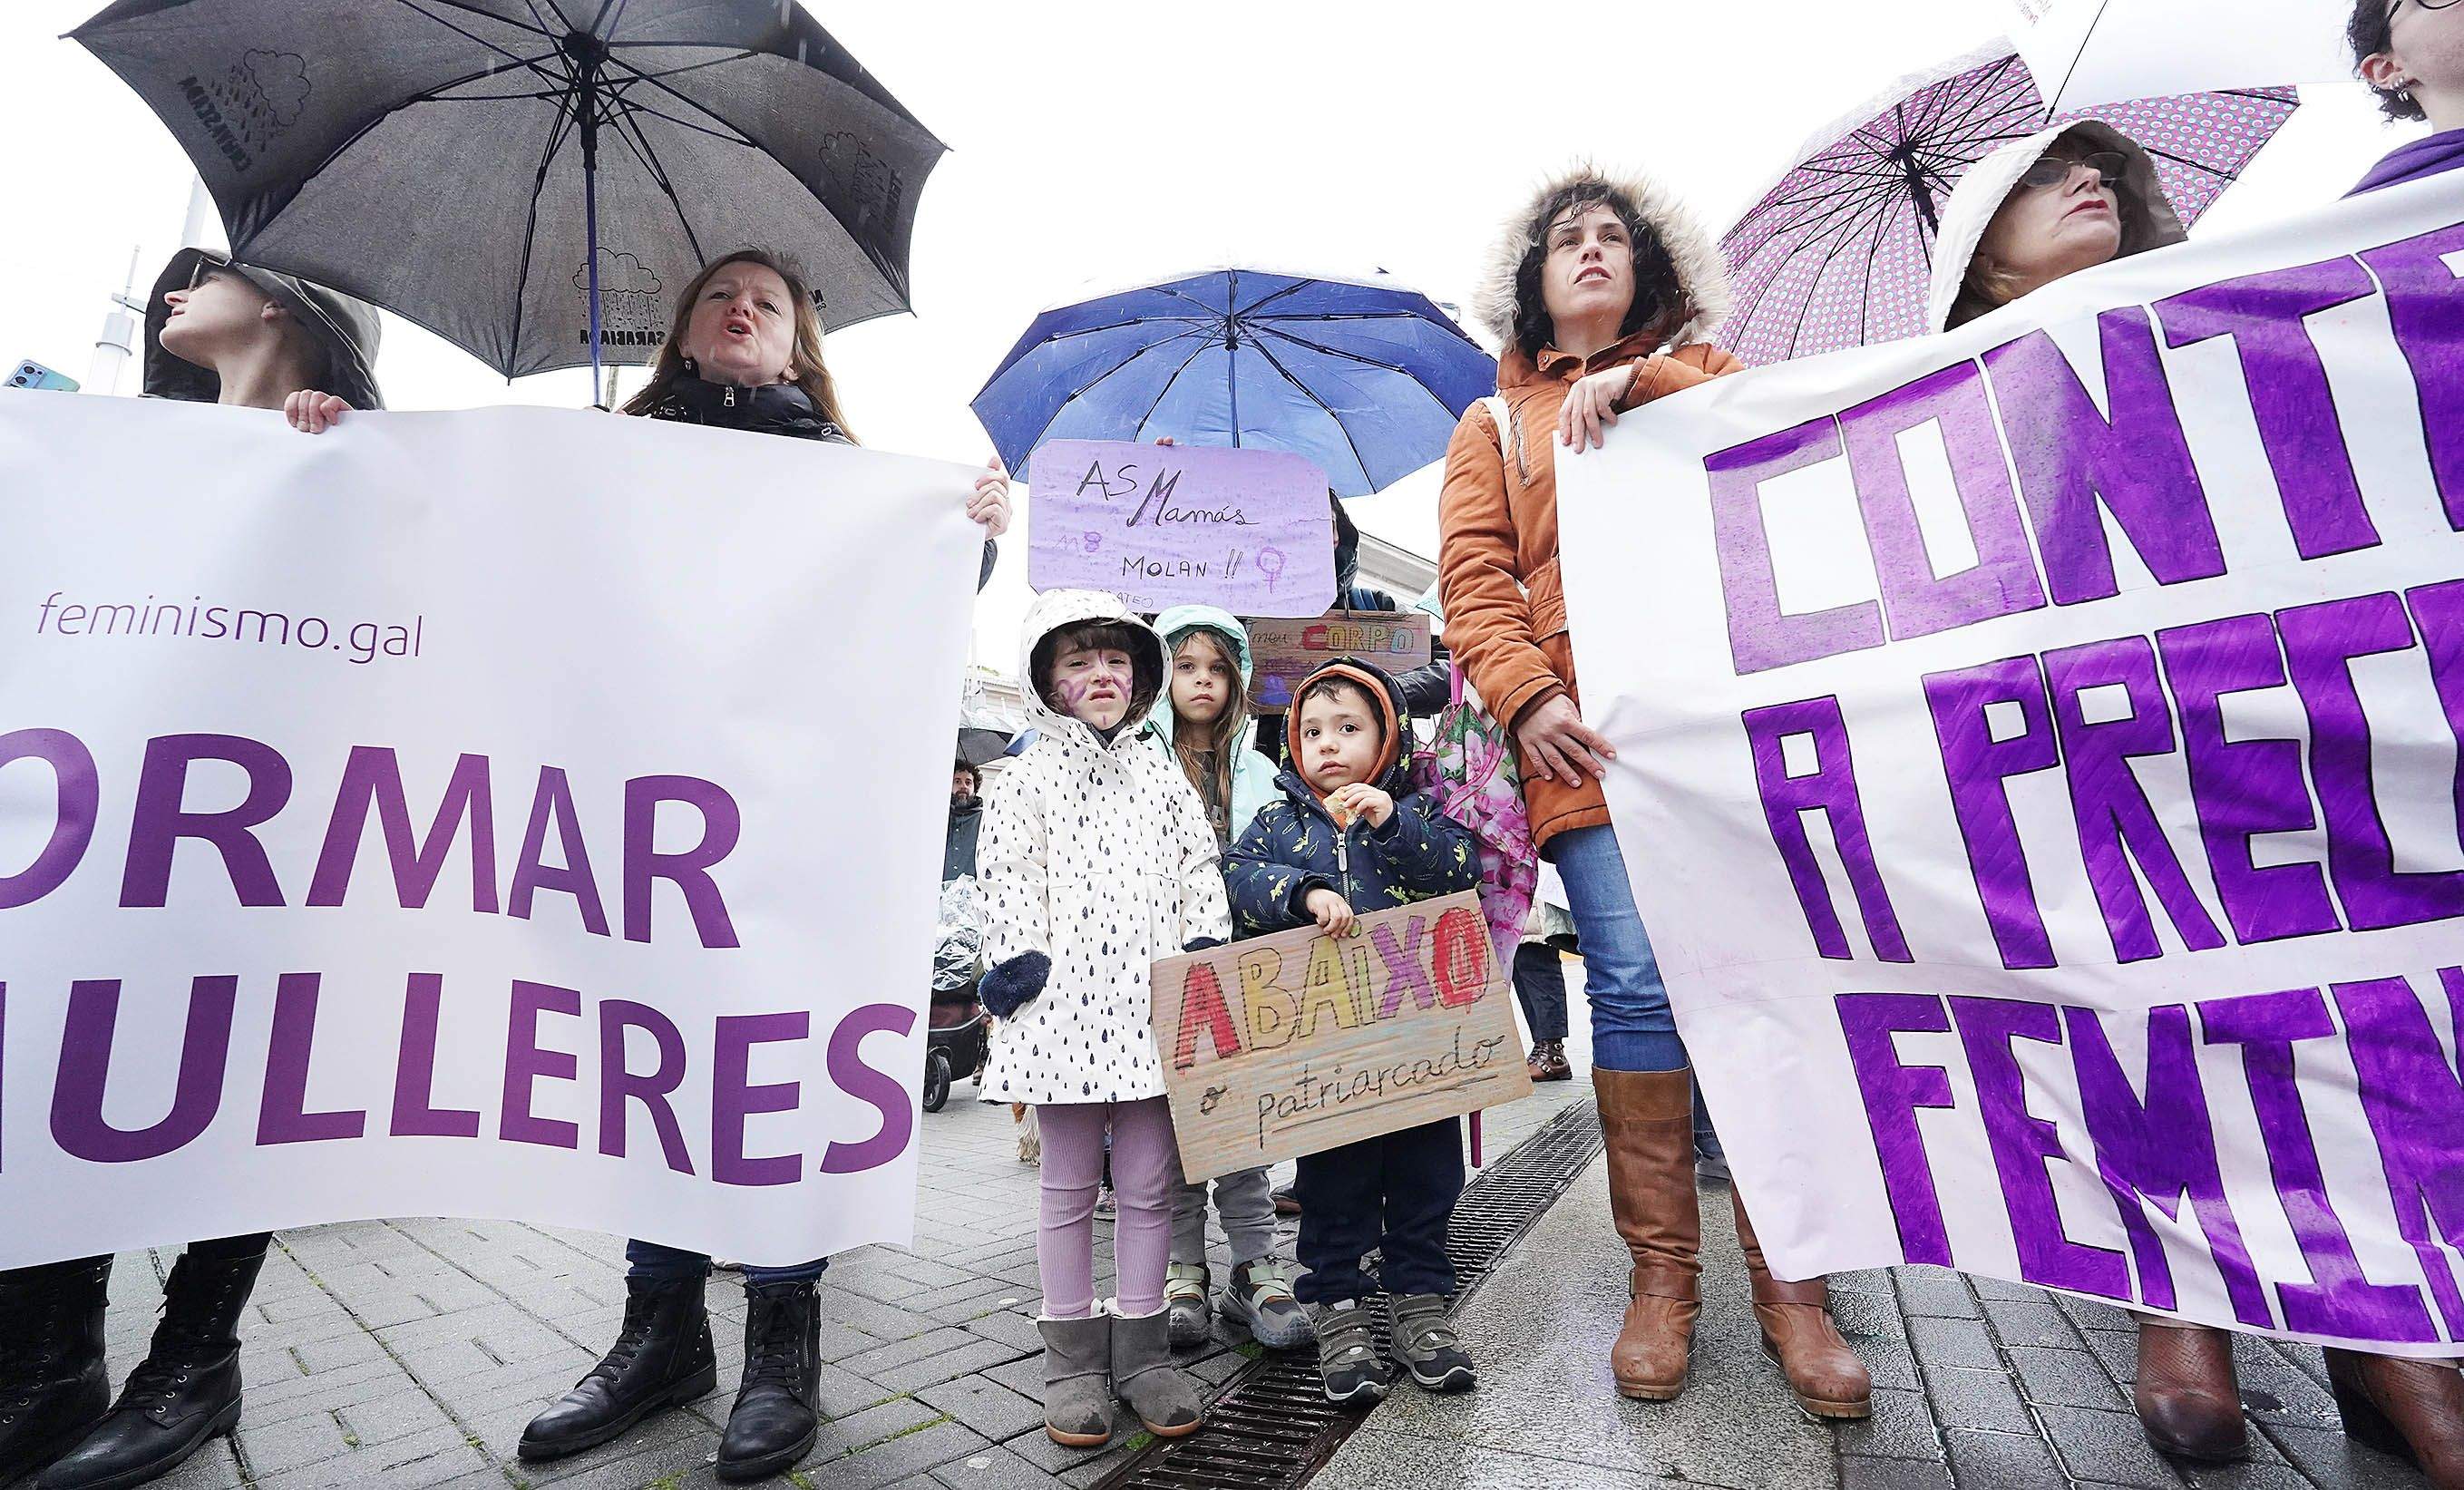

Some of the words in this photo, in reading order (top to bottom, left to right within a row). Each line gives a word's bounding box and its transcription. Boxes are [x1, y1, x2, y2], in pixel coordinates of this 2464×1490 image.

[1076, 460, 1138, 502] AS
[1125, 466, 1261, 529] Mamás
[1098, 589, 1154, 609] ATEO
[1122, 555, 1208, 580] MOLAN
[36, 591, 423, 666] feminismo.gal
[1301, 623, 1415, 655] CORPO
[1741, 694, 1914, 963] A
[0, 971, 917, 1187] ULLERES
[1199, 1083, 1228, 1116] o
[1257, 1025, 1505, 1150] patriarcado
